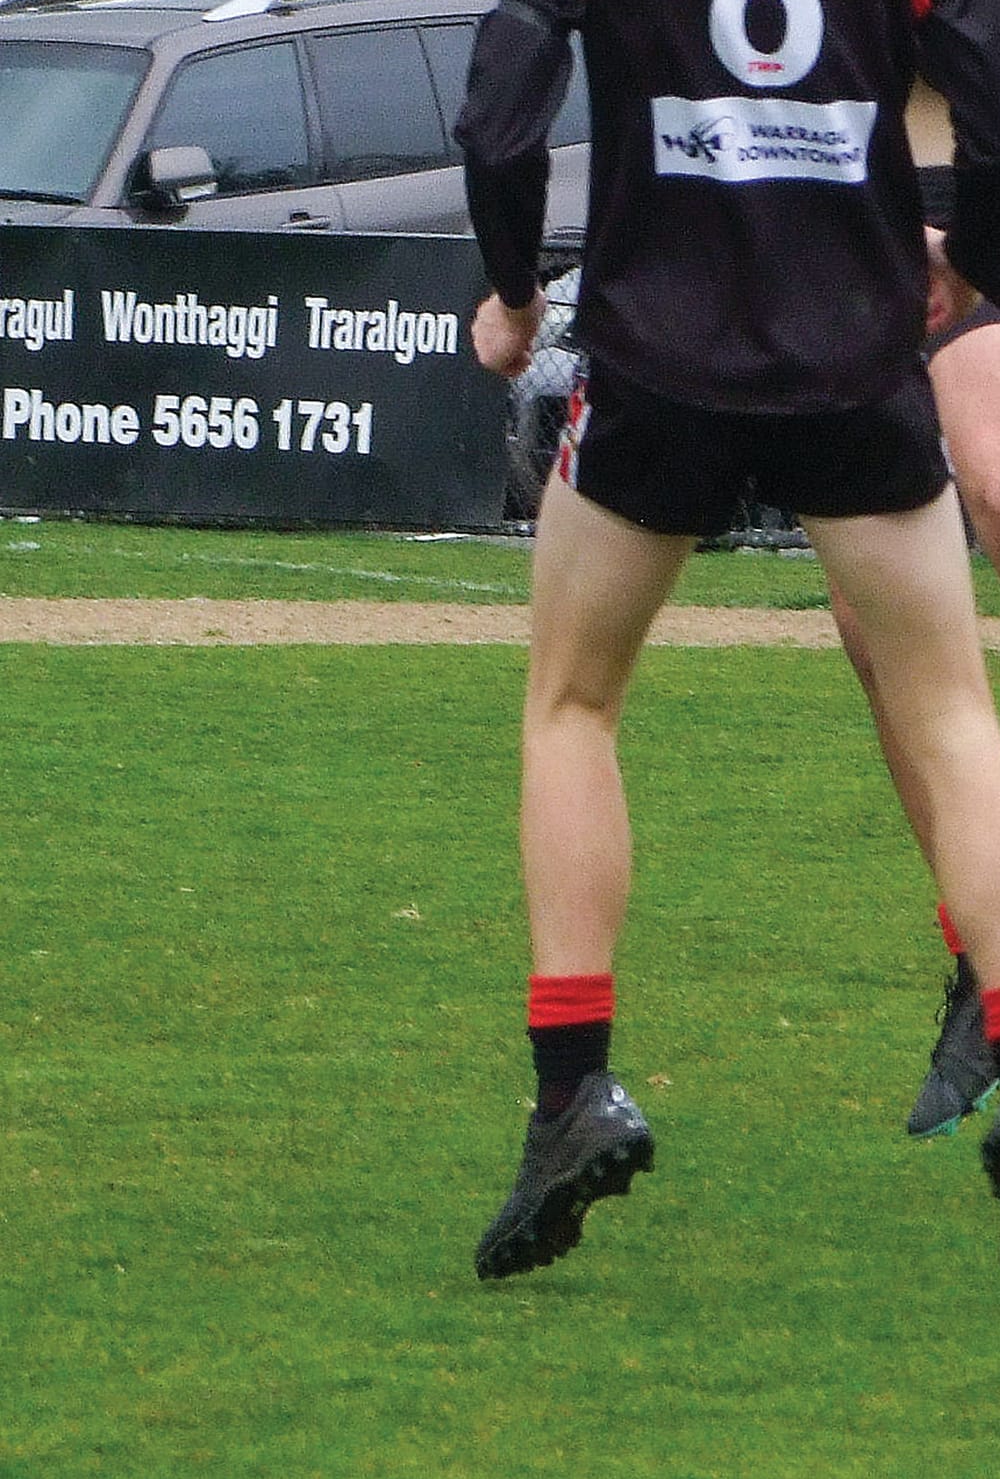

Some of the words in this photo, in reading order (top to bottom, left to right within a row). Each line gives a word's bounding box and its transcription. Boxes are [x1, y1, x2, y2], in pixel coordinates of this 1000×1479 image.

[101, 289, 279, 359] Wonthaggi
[304, 296, 458, 364] Traralgon
[3, 387, 140, 445] Phone
[151, 394, 260, 450] 5656
[272, 398, 373, 454] 1731
